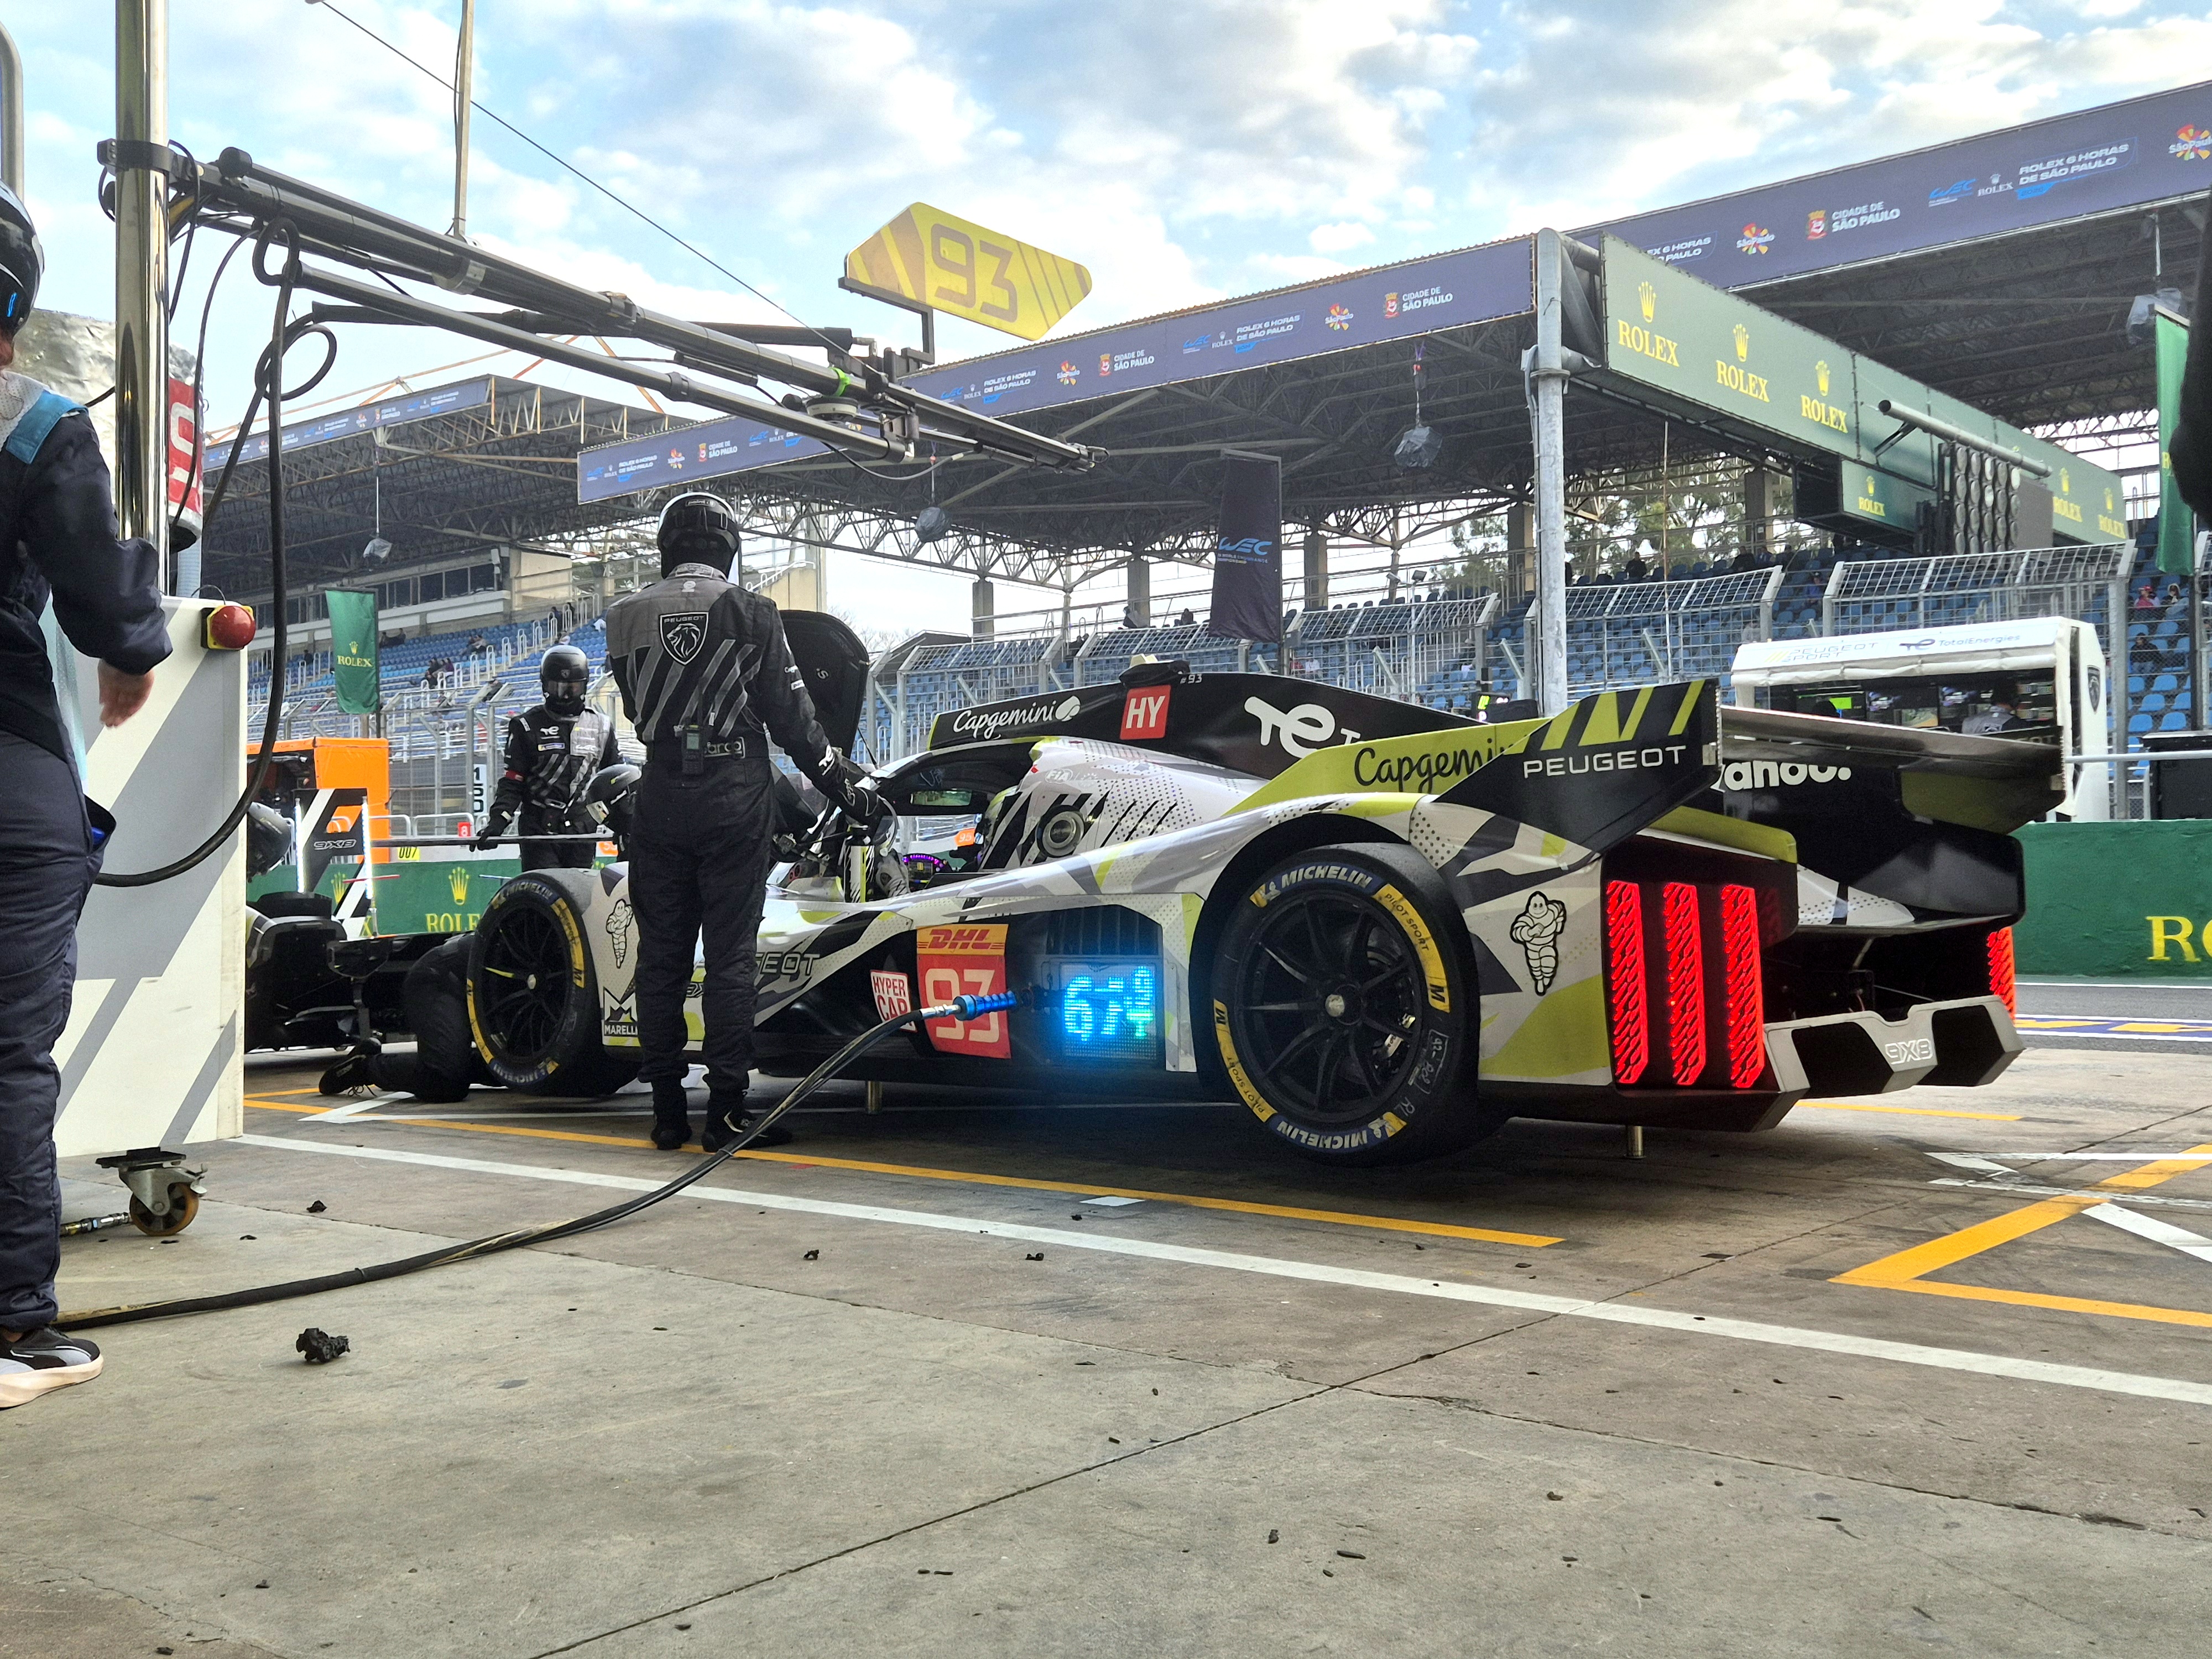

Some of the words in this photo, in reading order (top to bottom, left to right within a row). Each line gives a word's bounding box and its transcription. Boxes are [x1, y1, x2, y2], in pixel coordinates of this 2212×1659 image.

[2019, 159, 2065, 175] ROLEX
[2066, 155, 2077, 164] 6
[2078, 144, 2129, 162] HORAS
[2019, 174, 2039, 185] DE
[2040, 168, 2069, 180] SÃO
[2070, 156, 2117, 174] PAULO
[1978, 182, 2013, 196] ROLEX
[1832, 204, 1868, 220] CIDADE
[1870, 200, 1885, 211] DE
[1832, 217, 1858, 232] SÃO
[1859, 208, 1901, 227] PAULO
[1673, 236, 1712, 250] HORAS
[931, 223, 1018, 322] 93
[1402, 289, 1430, 301] CIDADE
[1431, 286, 1441, 295] DE
[1402, 299, 1421, 312] SÃO
[1423, 293, 1453, 307] PAULO
[1236, 322, 1263, 334] ROLEX
[1271, 315, 1301, 326] HORAS
[1248, 331, 1266, 340] SÃO
[1266, 324, 1293, 335] PAULO
[1212, 339, 1233, 348] ROLEX
[1618, 319, 1679, 367] ROLEX
[1114, 351, 1135, 362] CIDADE
[1114, 360, 1130, 372] SÃO
[1130, 356, 1155, 368] PAULO
[1715, 360, 1770, 414] ROLEX
[1801, 394, 1849, 434] ROLEX
[1859, 496, 1886, 517] ROLEX
[1218, 536, 1272, 556] WEC
[664, 615, 706, 623] PEUGEOT
[1790, 643, 1878, 655] PEUGEOT
[1939, 634, 2020, 646] TotalEnergies
[337, 655, 373, 667] ROLEX
[1782, 651, 1843, 662] SPORT
[953, 700, 1057, 740] Capgemini
[1125, 695, 1166, 729] HY
[1354, 738, 1515, 794] Capgemi
[1524, 745, 1687, 779] PEUGEOT
[314, 839, 357, 851] 9X8
[1281, 865, 1373, 889] MICHELIN
[1384, 893, 1408, 918] PILOT
[1406, 916, 1430, 952] SPORT
[928, 928, 993, 951] DHL
[872, 975, 906, 997] HYPER
[1429, 983, 1447, 1003] M
[924, 968, 1000, 1043] 93
[1885, 1038, 1933, 1065] 9X8
[1227, 1055, 1246, 1094] SPORT
[1243, 1089, 1265, 1114] PILOT
[1276, 1121, 1368, 1150] MICHELIN
